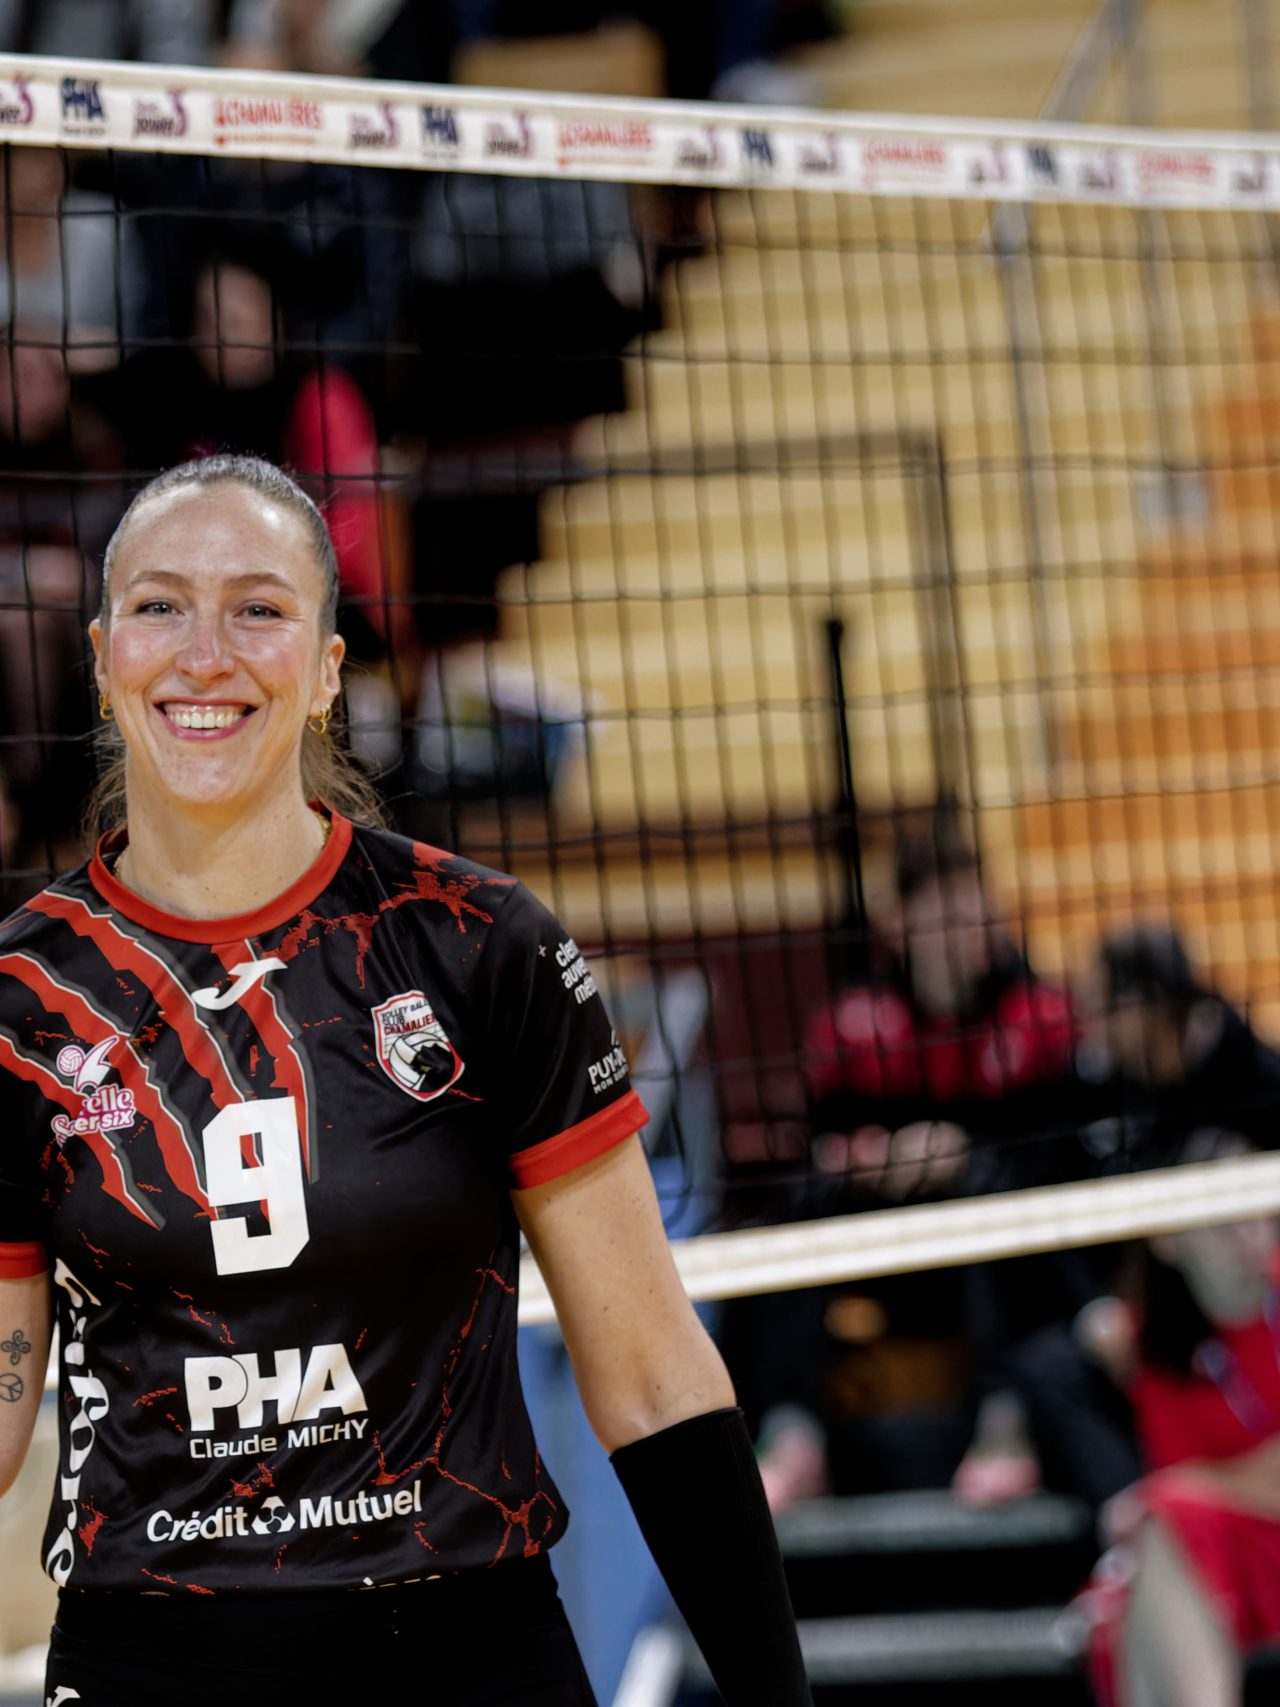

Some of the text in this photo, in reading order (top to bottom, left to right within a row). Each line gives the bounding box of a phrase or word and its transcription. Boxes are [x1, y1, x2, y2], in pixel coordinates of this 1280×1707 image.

[202, 1096, 310, 1276] 9
[184, 1343, 368, 1432] PHA
[189, 1418, 369, 1460] Claude MICHY
[146, 1480, 423, 1542] Crédit Mutuel
